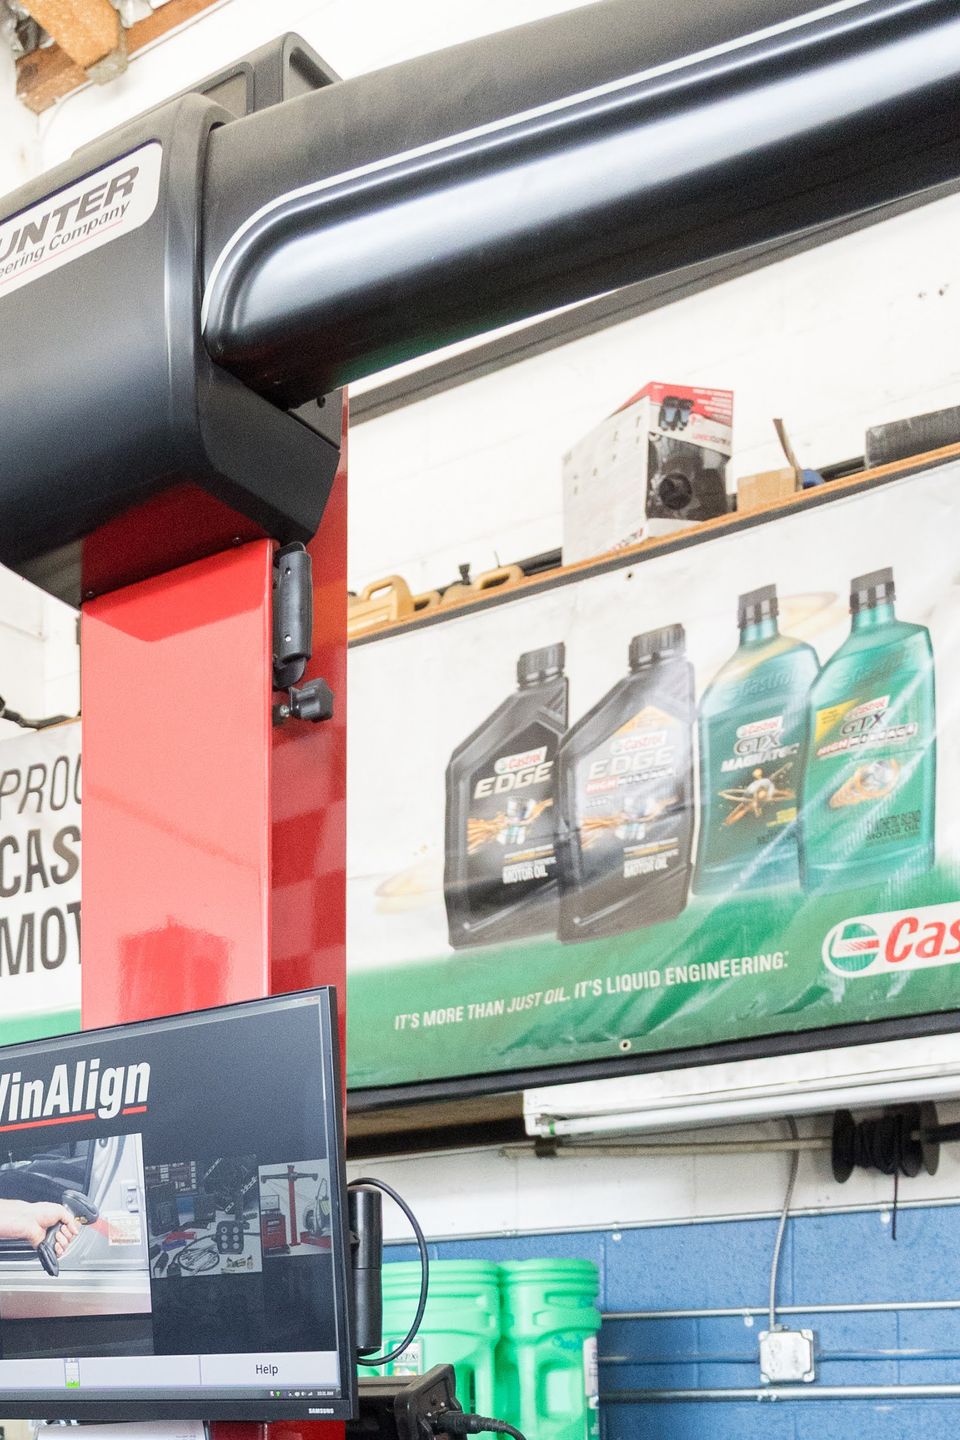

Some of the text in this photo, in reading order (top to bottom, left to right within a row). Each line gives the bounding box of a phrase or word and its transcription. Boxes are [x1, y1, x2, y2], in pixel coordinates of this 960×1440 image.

[49, 199, 131, 251] Company
[473, 761, 554, 799] EDGE
[588, 746, 675, 780] EDGE
[394, 1012, 420, 1030] IT'S
[422, 1007, 464, 1028] MORE
[467, 1000, 505, 1020] THAN
[507, 992, 543, 1014] JUST
[544, 988, 571, 1006] OIL.
[575, 979, 602, 1000] IT'S
[606, 969, 662, 995] LIQUID
[255, 1364, 279, 1376] Help
